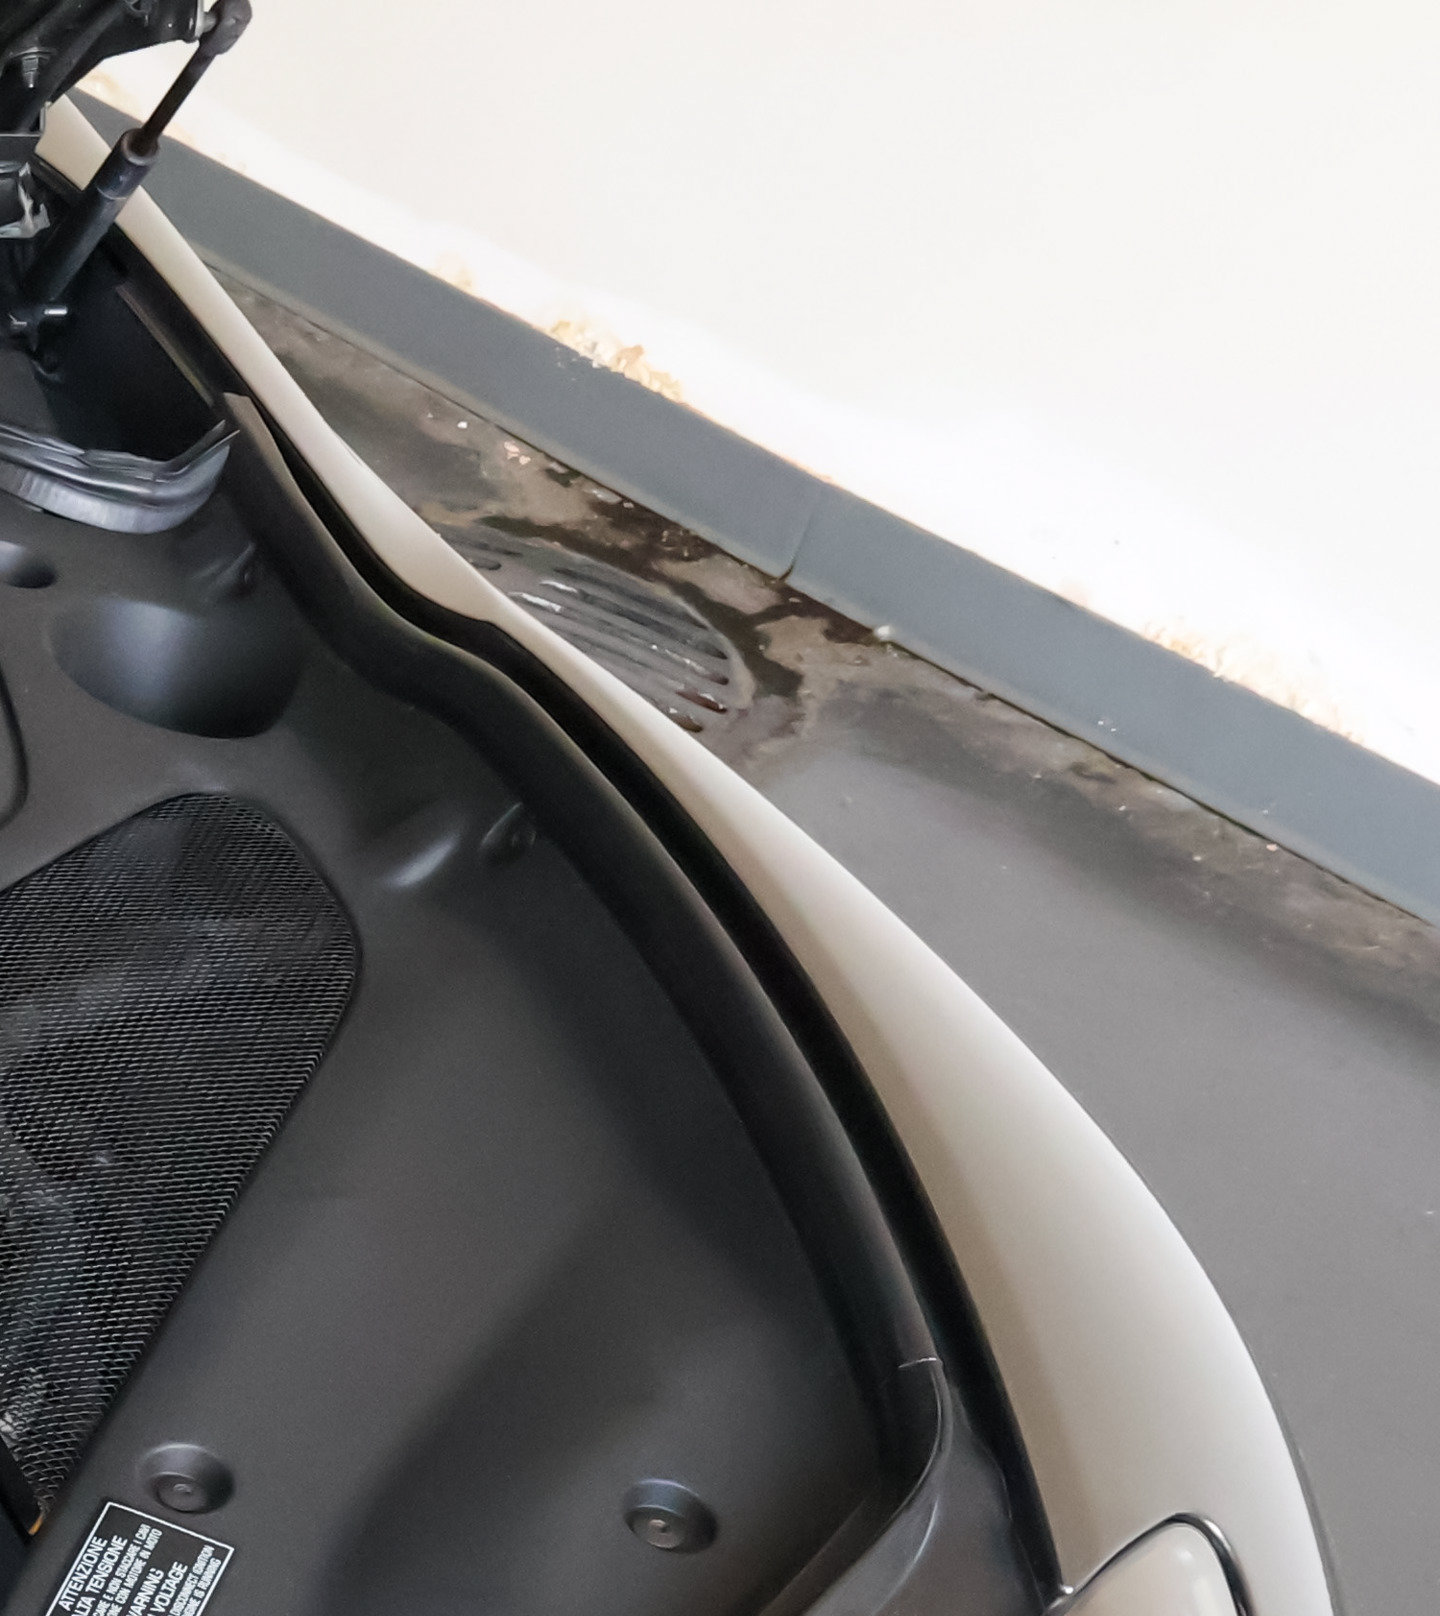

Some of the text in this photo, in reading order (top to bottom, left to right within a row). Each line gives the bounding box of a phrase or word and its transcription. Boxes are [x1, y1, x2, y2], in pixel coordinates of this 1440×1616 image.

[139, 1550, 151, 1559] IN
[144, 1529, 162, 1550] MOTO
[59, 1537, 107, 1611] ATTENZIONE
[85, 1535, 127, 1593] TENSIONE
[106, 1578, 122, 1594] NON
[115, 1544, 140, 1578] STACCARE
[123, 1558, 146, 1588] MOTORE
[198, 1558, 221, 1590] RUNNING
[115, 1588, 131, 1604] CON
[150, 1562, 188, 1612] VOLTAGE
[170, 1573, 199, 1616] DISCONNECT
[193, 1589, 205, 1598] IS
